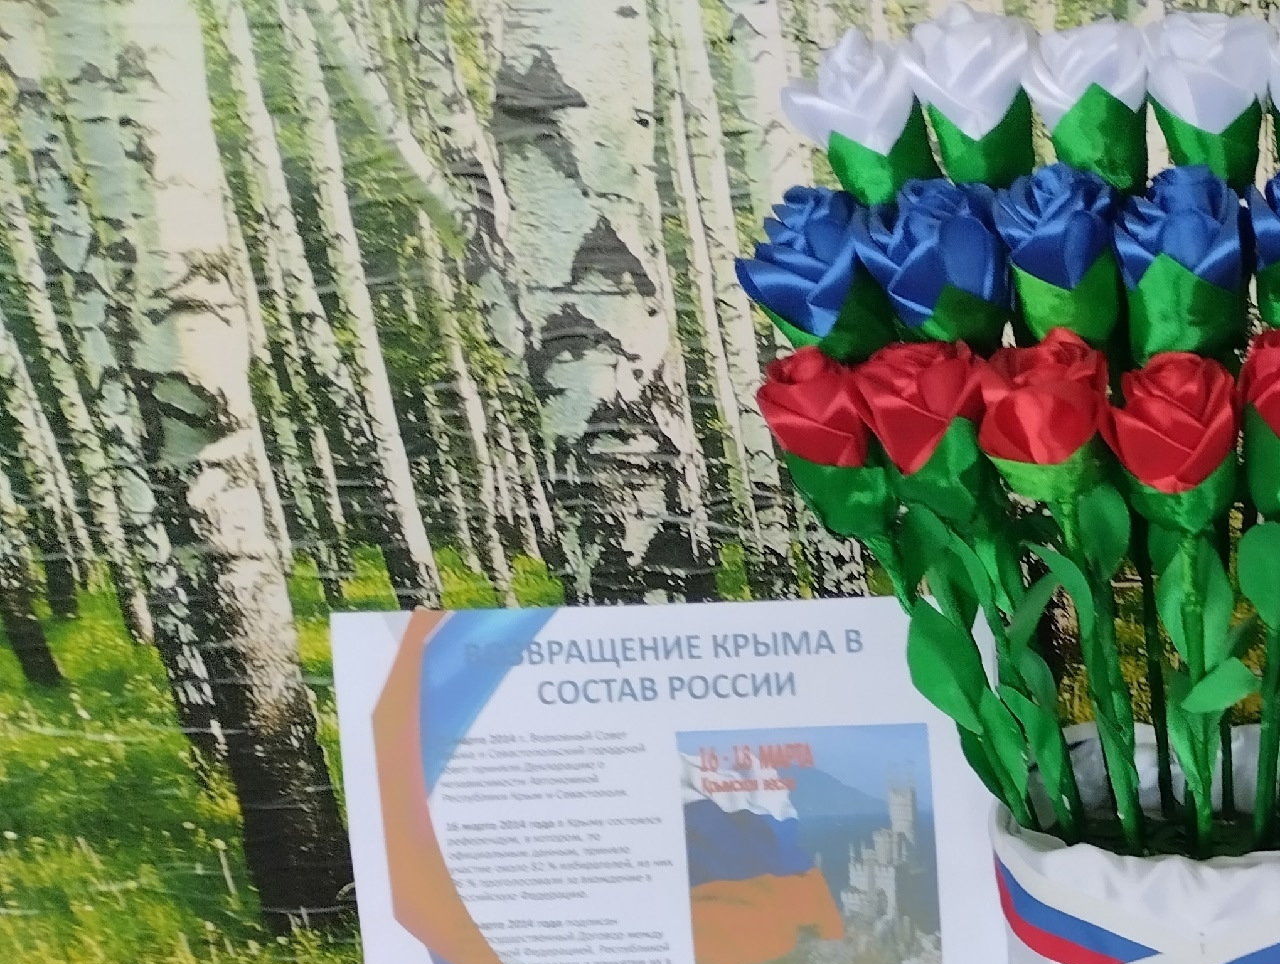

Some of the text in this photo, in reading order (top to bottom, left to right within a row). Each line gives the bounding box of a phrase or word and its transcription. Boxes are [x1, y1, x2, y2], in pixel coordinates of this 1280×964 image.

[712, 629, 837, 659] КРЫМА
[845, 629, 864, 654] В
[537, 672, 797, 705] СОСТАВ РОССИИ
